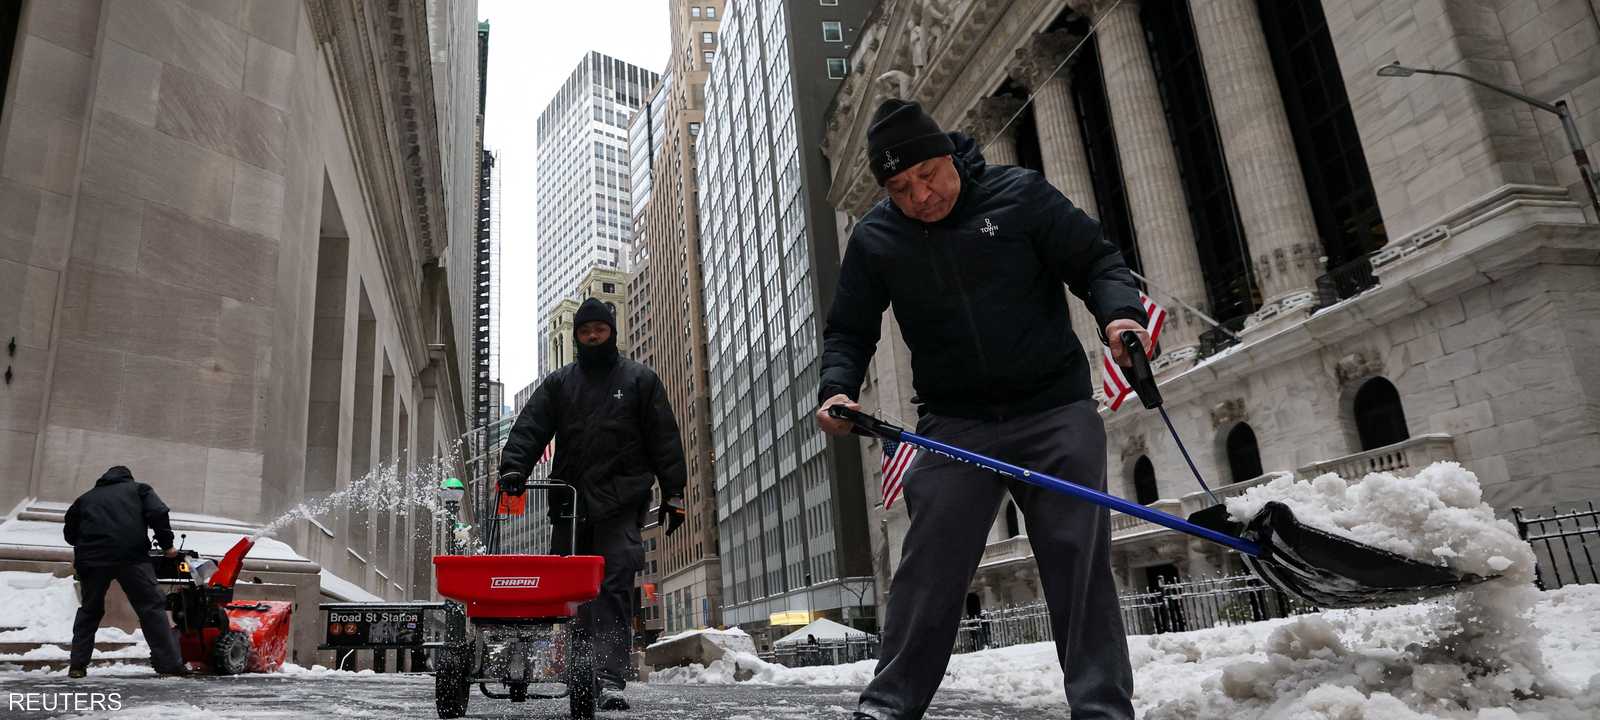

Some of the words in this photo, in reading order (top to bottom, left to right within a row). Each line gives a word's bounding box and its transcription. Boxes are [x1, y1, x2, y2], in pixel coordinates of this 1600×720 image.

[330, 612, 361, 622] Broad
[366, 612, 377, 622] St
[381, 612, 418, 622] Station
